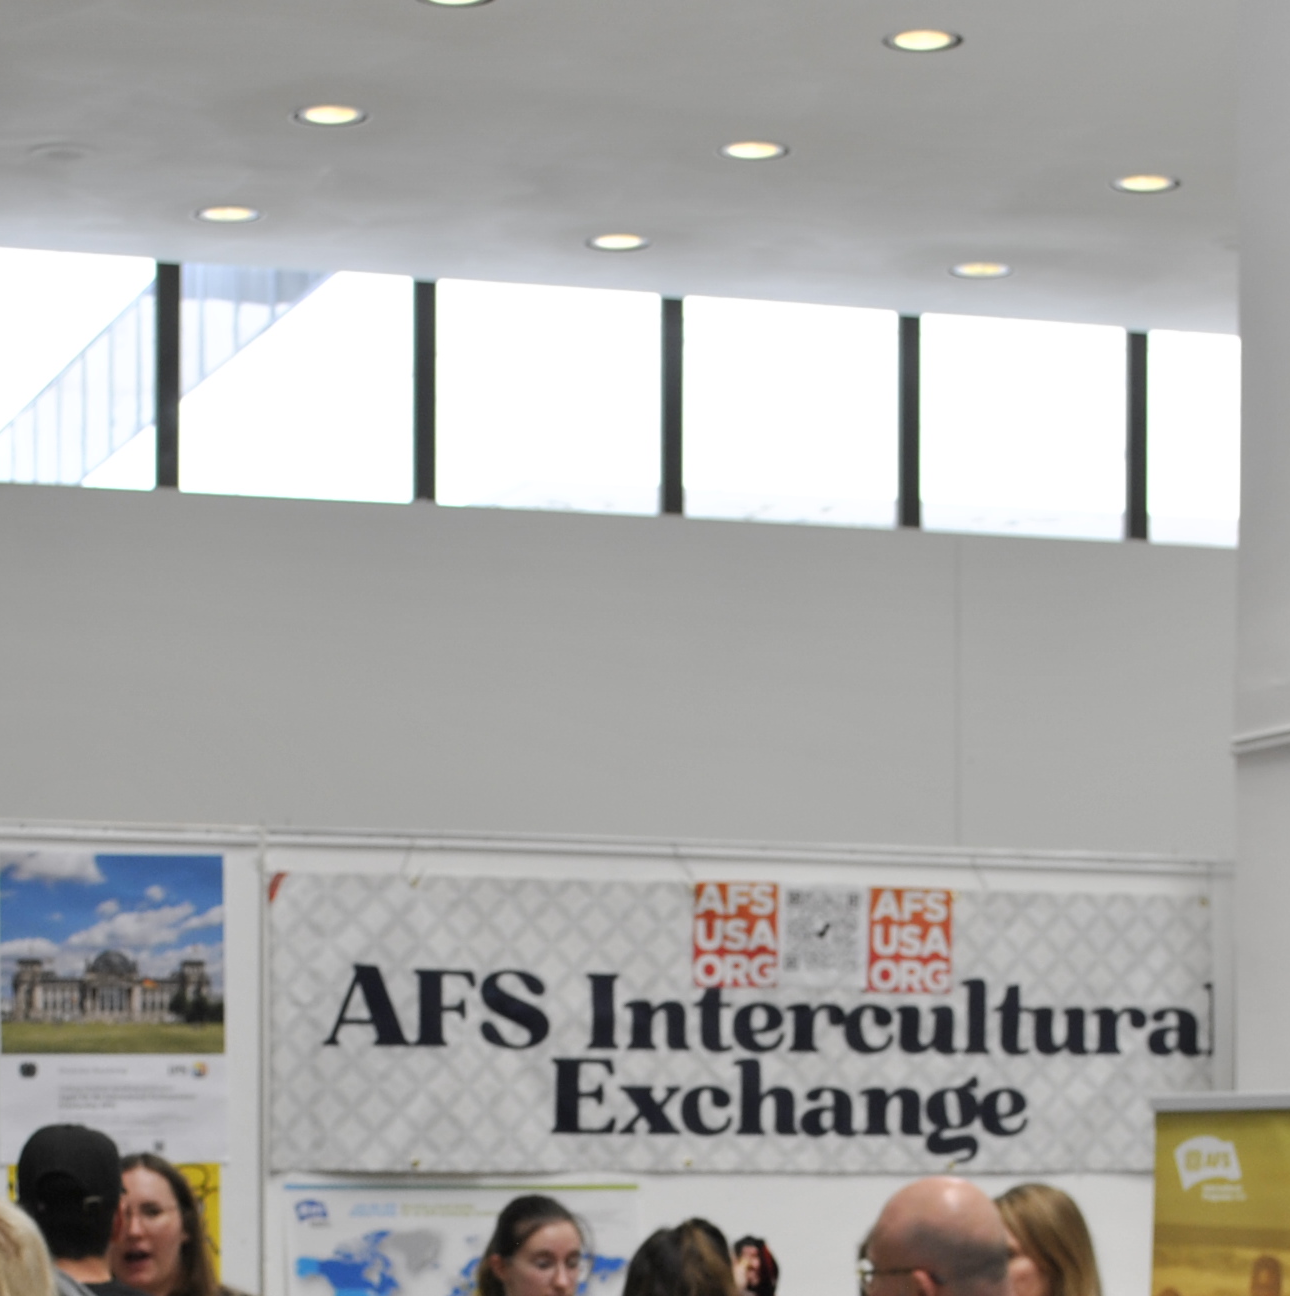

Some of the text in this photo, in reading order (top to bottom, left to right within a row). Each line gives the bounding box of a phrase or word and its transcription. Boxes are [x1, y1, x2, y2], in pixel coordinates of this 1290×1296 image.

[694, 884, 776, 915] AFS
[872, 890, 949, 922] AFS
[695, 918, 776, 951] USA
[872, 925, 950, 957] USA
[694, 953, 777, 988] ORG
[870, 959, 951, 993] ORG
[323, 963, 1213, 1057] AFS Intercultura
[551, 1058, 1028, 1163] Exchange
